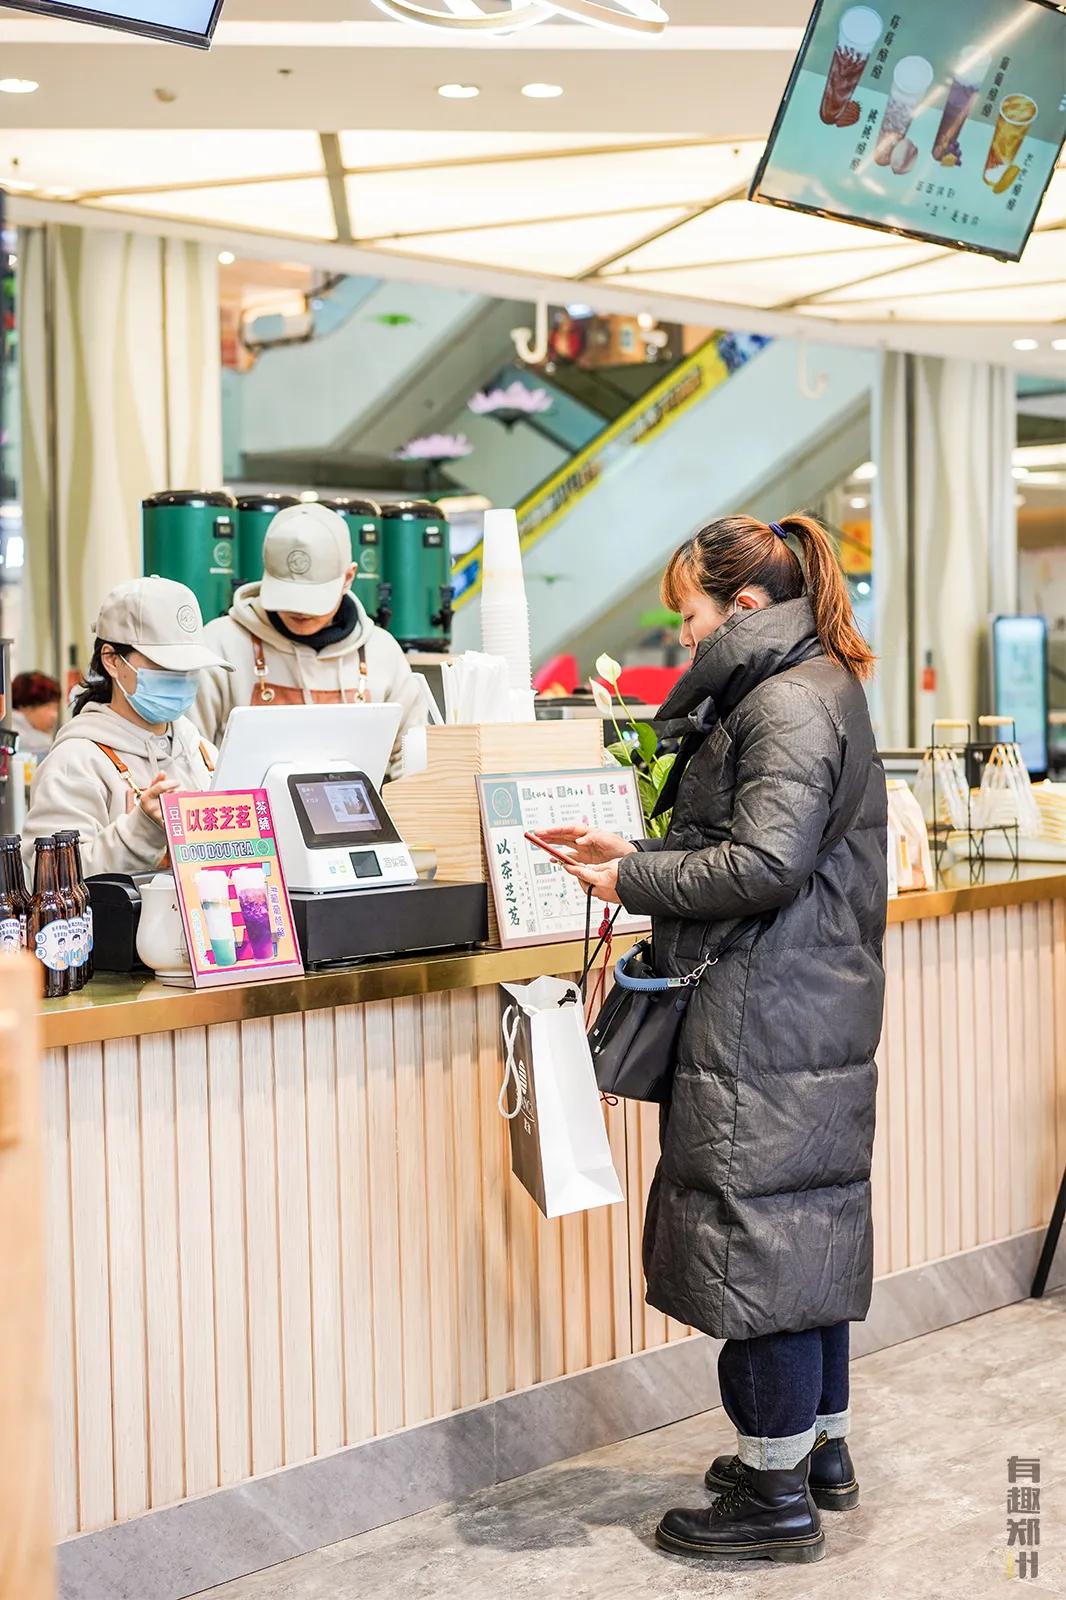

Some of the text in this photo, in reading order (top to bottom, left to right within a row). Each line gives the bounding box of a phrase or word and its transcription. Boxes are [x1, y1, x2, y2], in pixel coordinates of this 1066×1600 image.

[168, 806, 184, 837] 豆豆
[186, 804, 252, 832] 以茶芝茗
[496, 838, 521, 926] 以茶芝茗
